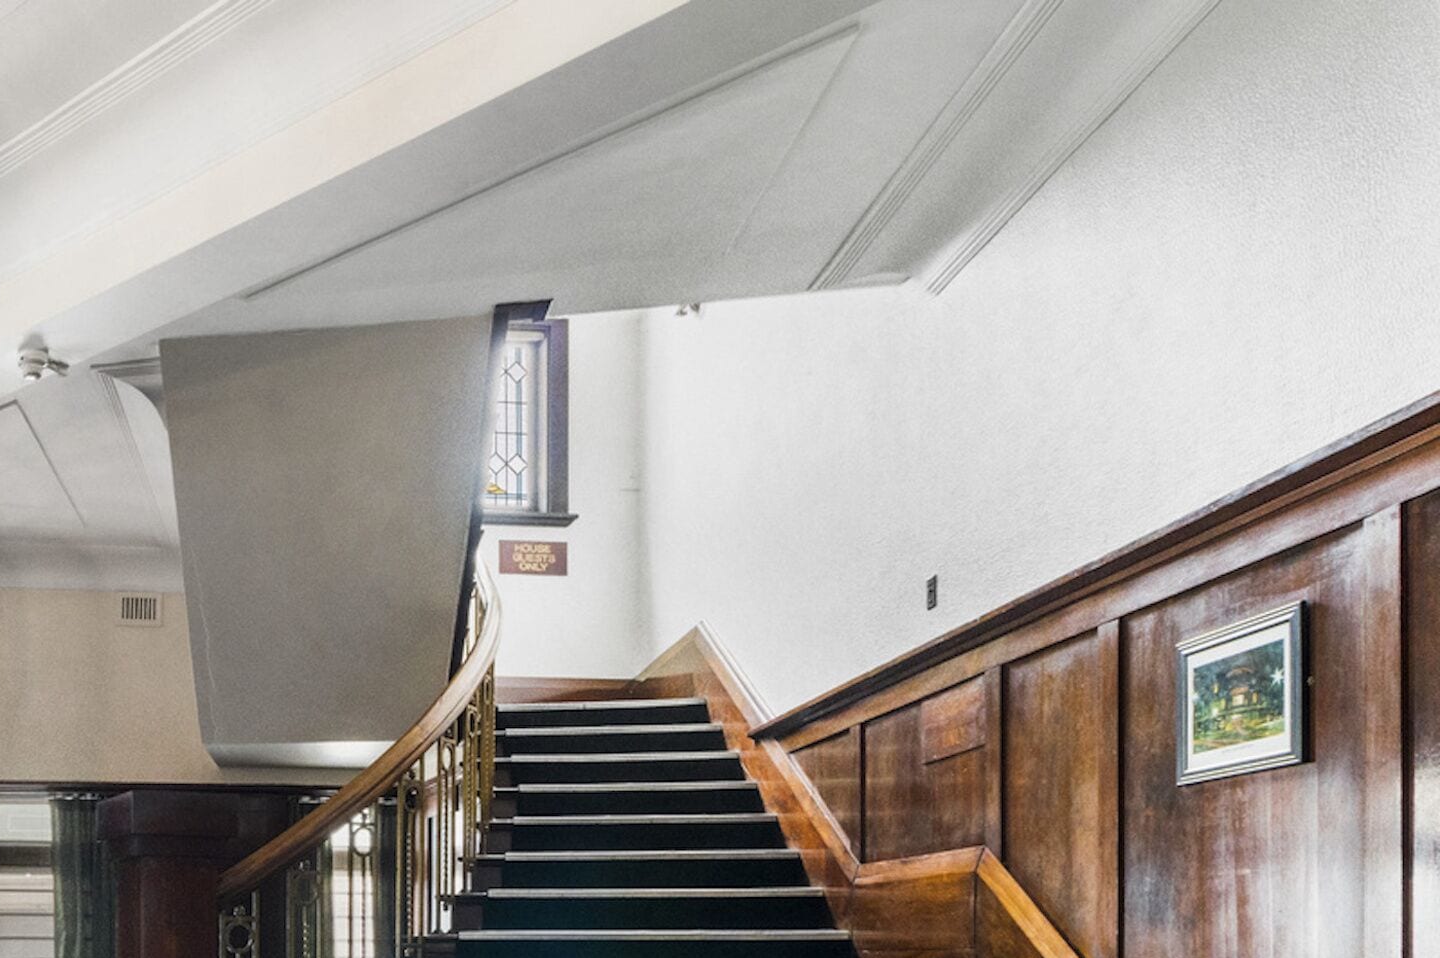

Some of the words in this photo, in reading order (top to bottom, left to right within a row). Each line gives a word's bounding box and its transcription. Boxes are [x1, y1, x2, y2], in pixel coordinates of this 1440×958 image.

[514, 543, 552, 553] HOUSE
[512, 553, 556, 564] GUESTS
[519, 562, 549, 572] ONLY
